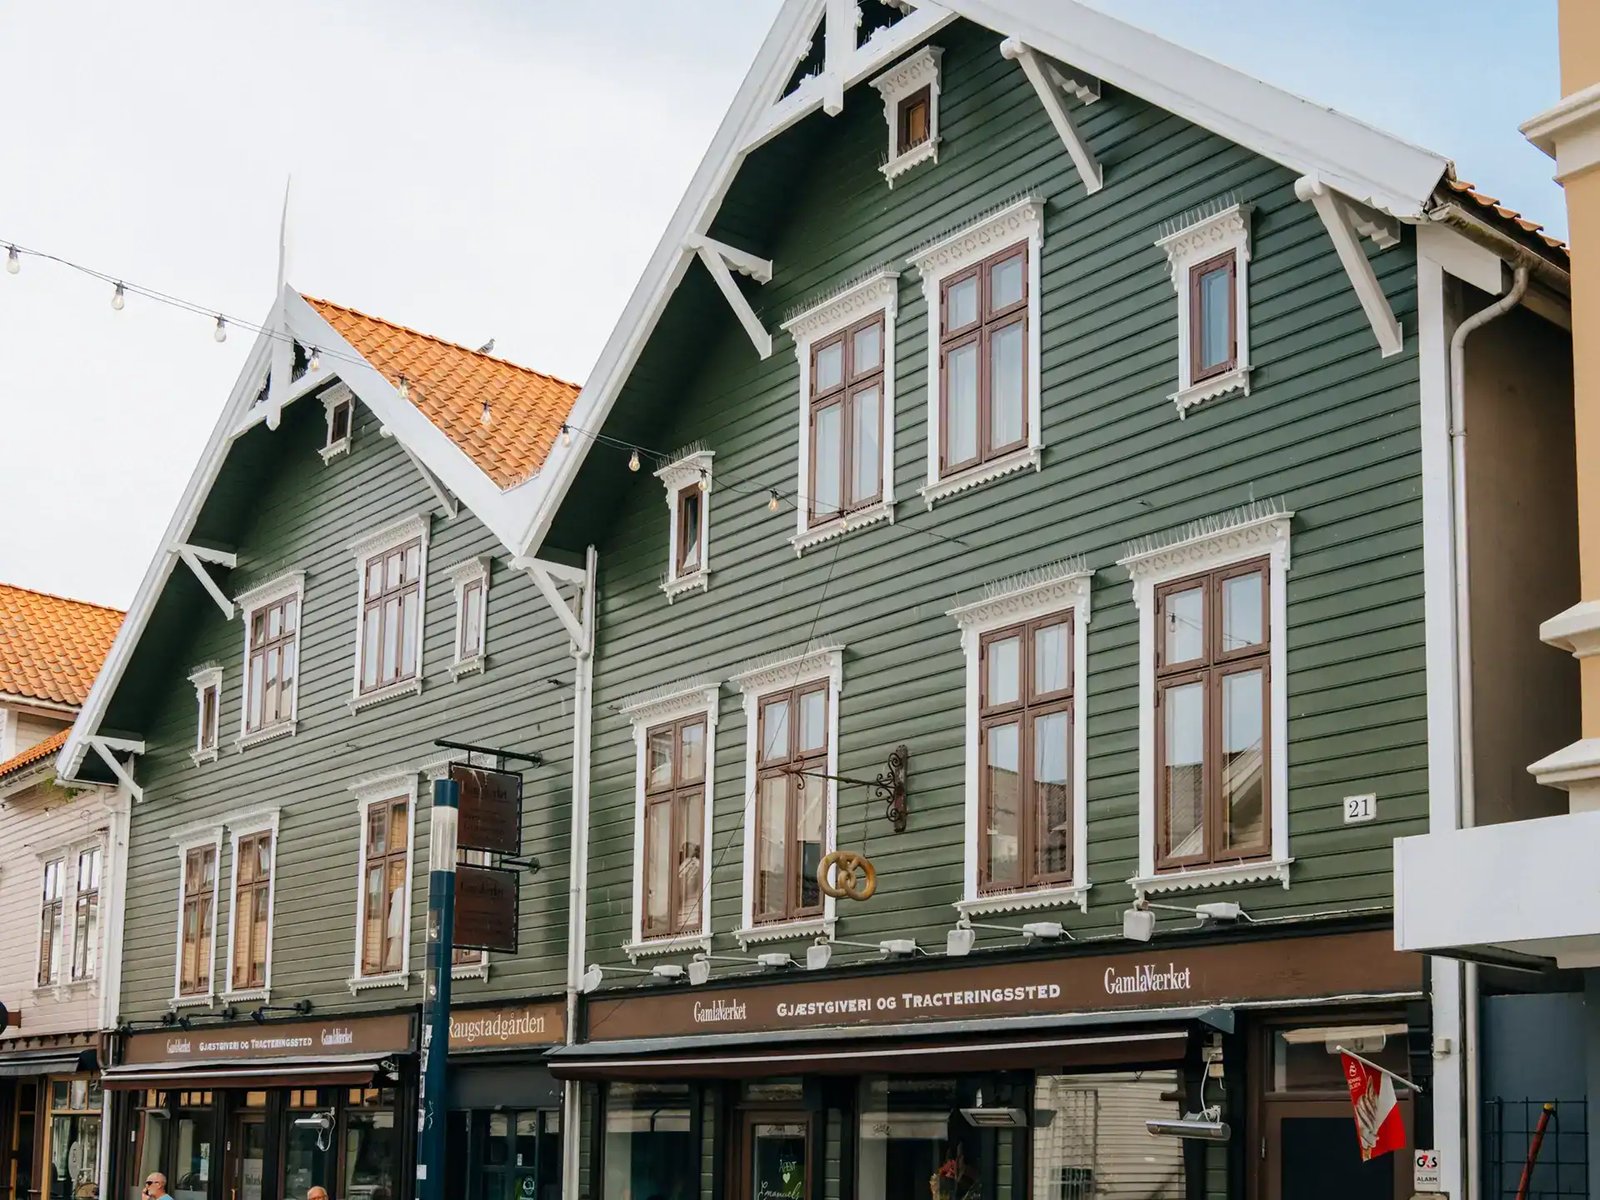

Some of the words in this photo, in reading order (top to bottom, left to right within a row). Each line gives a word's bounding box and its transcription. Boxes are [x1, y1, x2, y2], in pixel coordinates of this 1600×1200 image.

[1349, 799, 1370, 818] 21
[1104, 963, 1191, 995] GamlaVærket
[693, 998, 747, 1022] GamlaVærket
[777, 999, 872, 1017] GJÆSTGIVERI
[902, 984, 1061, 1009] TRACTERINGSSTED
